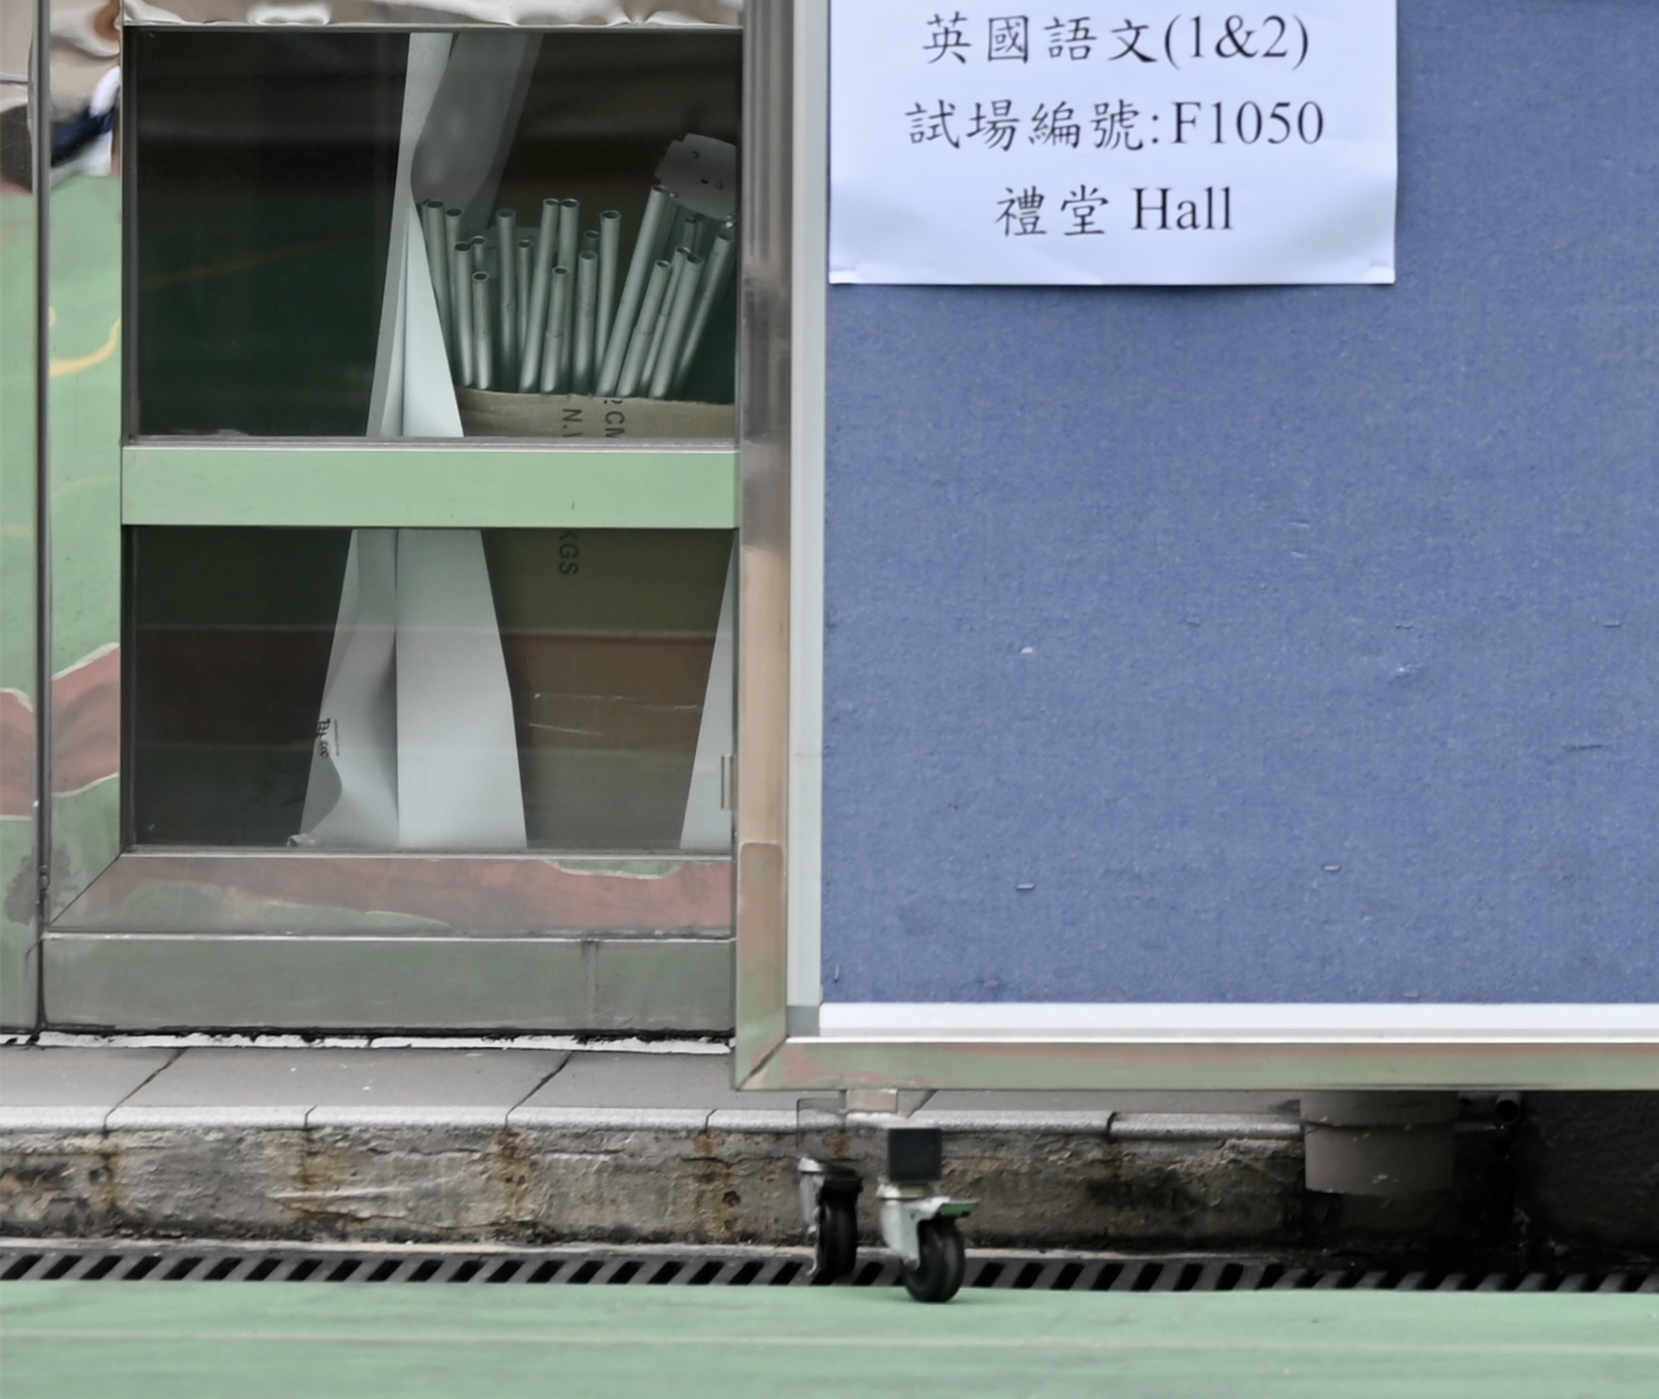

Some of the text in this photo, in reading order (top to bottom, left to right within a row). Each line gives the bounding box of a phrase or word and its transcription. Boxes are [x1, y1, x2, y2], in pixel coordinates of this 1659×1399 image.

[923, 14, 1308, 63] 英國語文(1&2)
[905, 100, 1323, 150] 試場編號:F1050
[996, 185, 1230, 235] 禮堂 Hall
